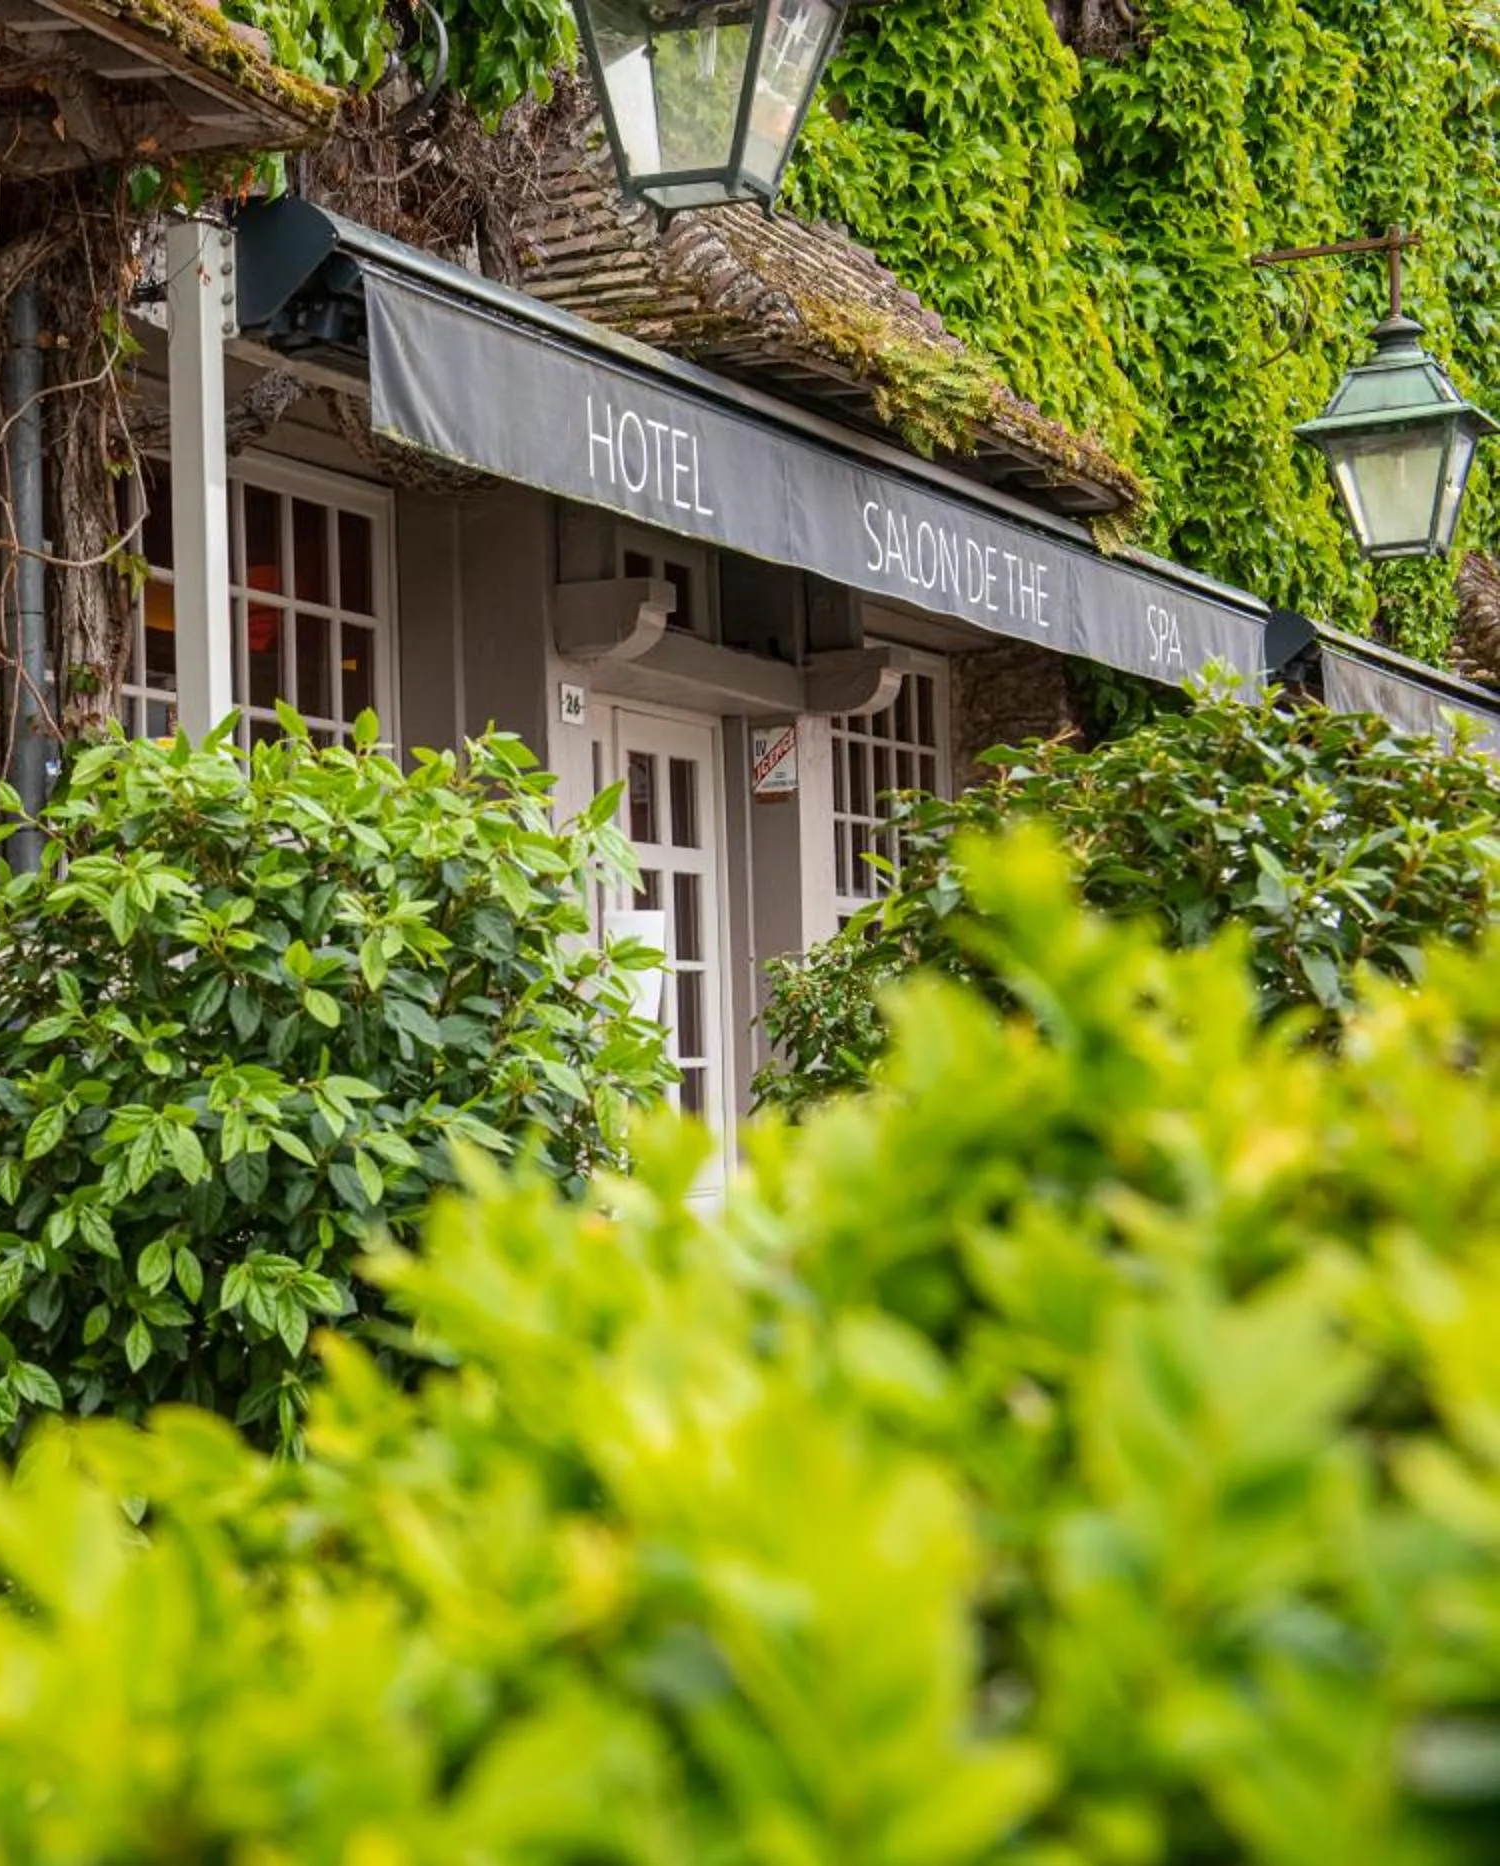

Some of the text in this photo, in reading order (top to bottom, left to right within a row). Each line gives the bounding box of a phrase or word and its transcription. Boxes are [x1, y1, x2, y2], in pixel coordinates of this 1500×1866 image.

[586, 394, 713, 516] HOTEL
[863, 501, 1050, 628] SALON DE THE
[1147, 604, 1184, 666] SPA
[565, 693, 581, 716] 26
